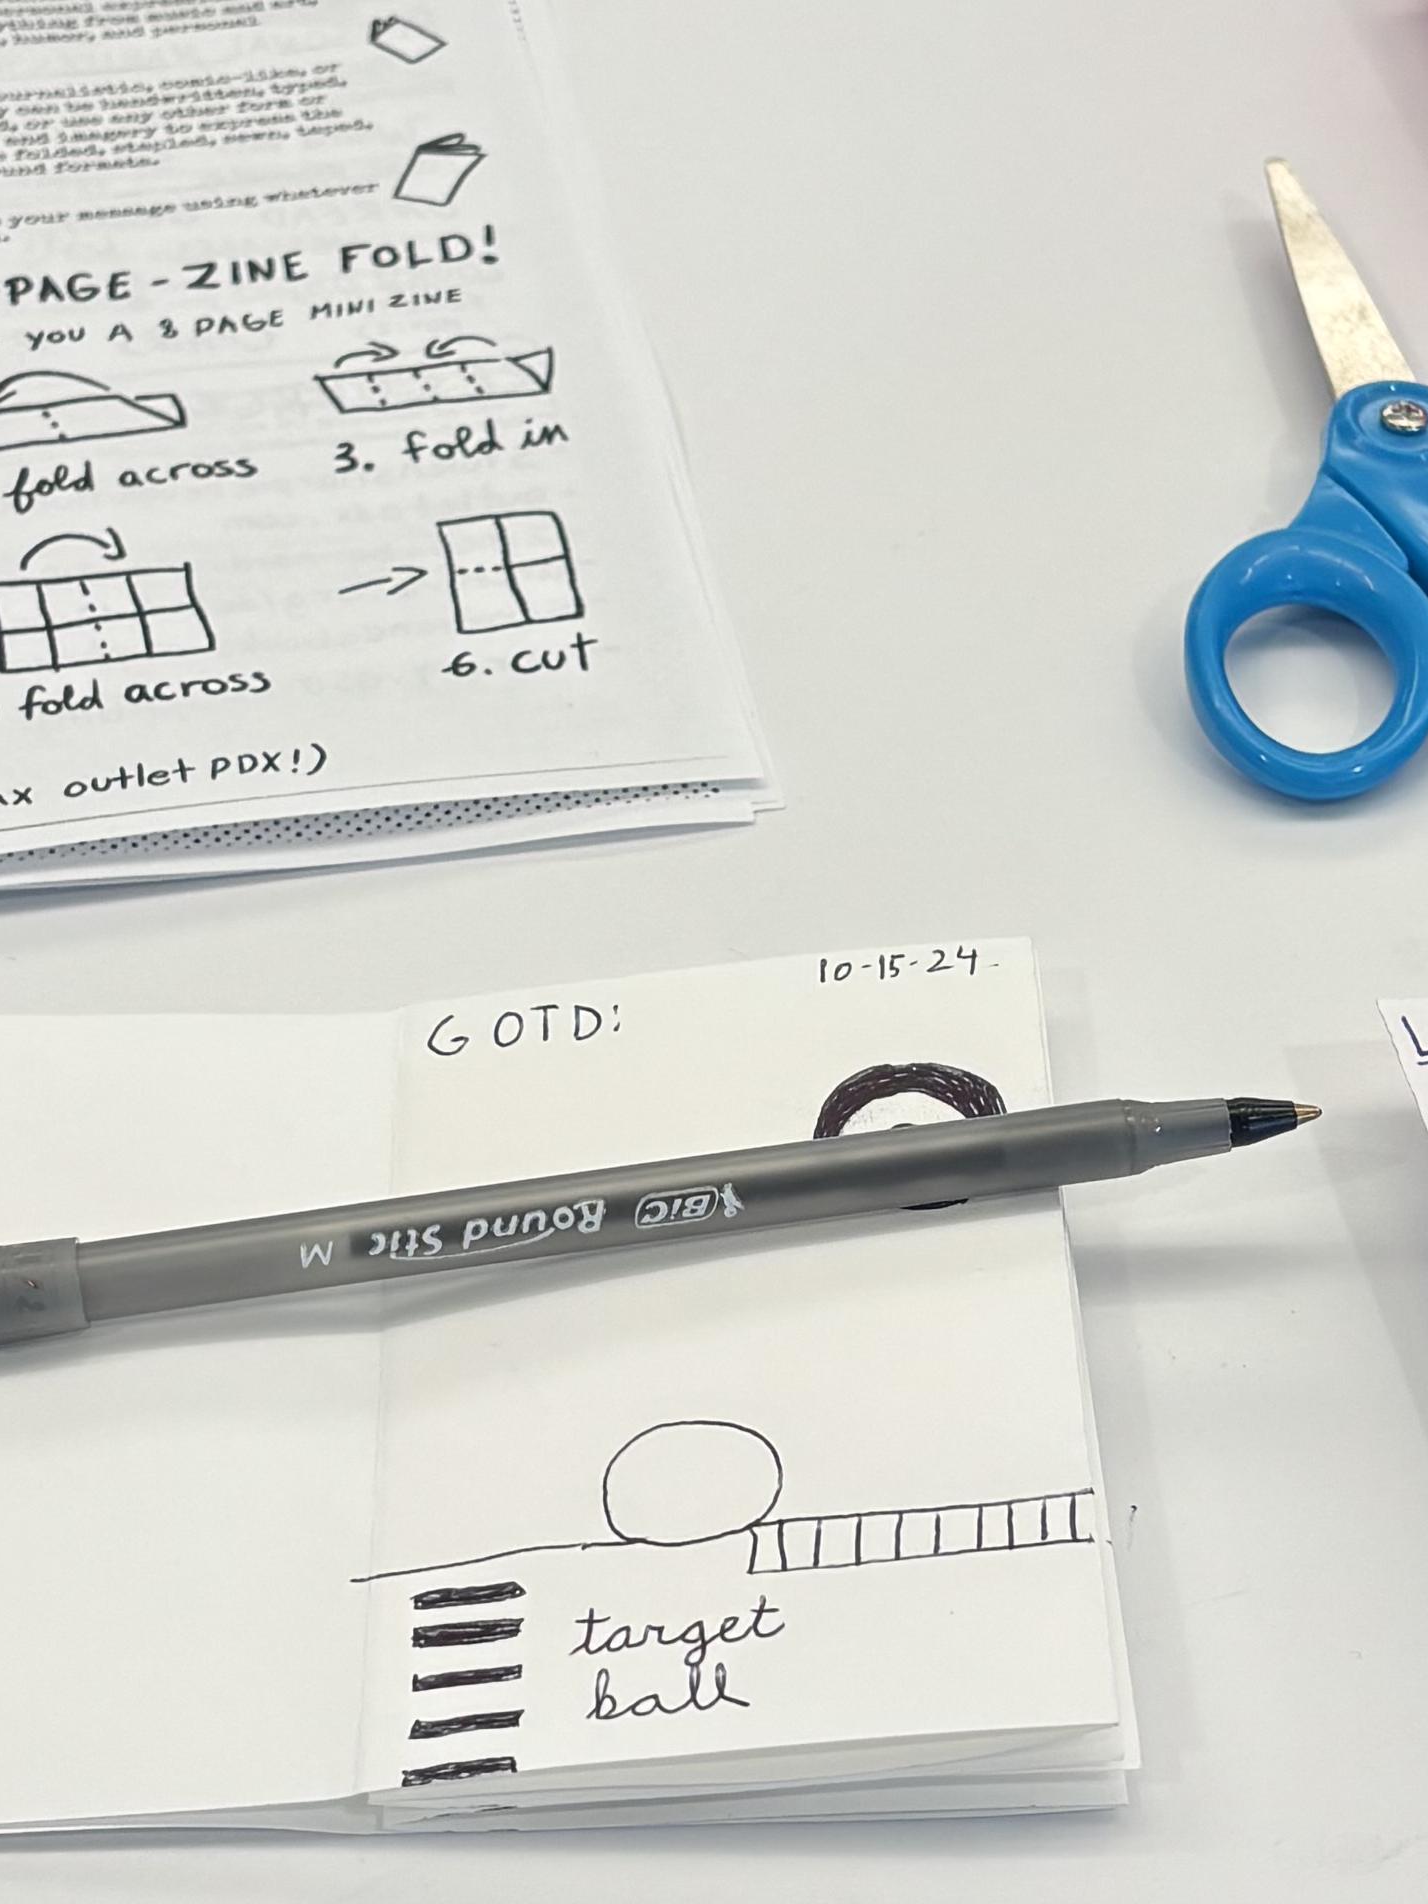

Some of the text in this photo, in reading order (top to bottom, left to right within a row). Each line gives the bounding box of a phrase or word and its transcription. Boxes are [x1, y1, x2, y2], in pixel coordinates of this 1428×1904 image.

[182, 250, 309, 290] ZINE
[339, 224, 499, 274] FOLD!
[24, 327, 85, 351] YOU
[107, 323, 133, 342] A
[194, 309, 283, 337] PAGE
[310, 298, 374, 320] MINI
[388, 288, 461, 308] ZINE
[334, 440, 375, 474] 3.
[519, 418, 569, 450] in
[2, 460, 95, 515] fold
[118, 458, 258, 488] across
[441, 632, 598, 677] 6. cut
[18, 678, 104, 721] fold
[124, 671, 271, 704] across
[63, 758, 196, 798] outlet
[211, 743, 327, 780] PDX!)
[425, 1001, 624, 1059] GOTD:
[368, 1223, 442, 1258] Stic
[462, 1198, 607, 1251] Round
[299, 1240, 334, 1269] M
[568, 1594, 789, 1667] target
[585, 1661, 751, 1721] ball
